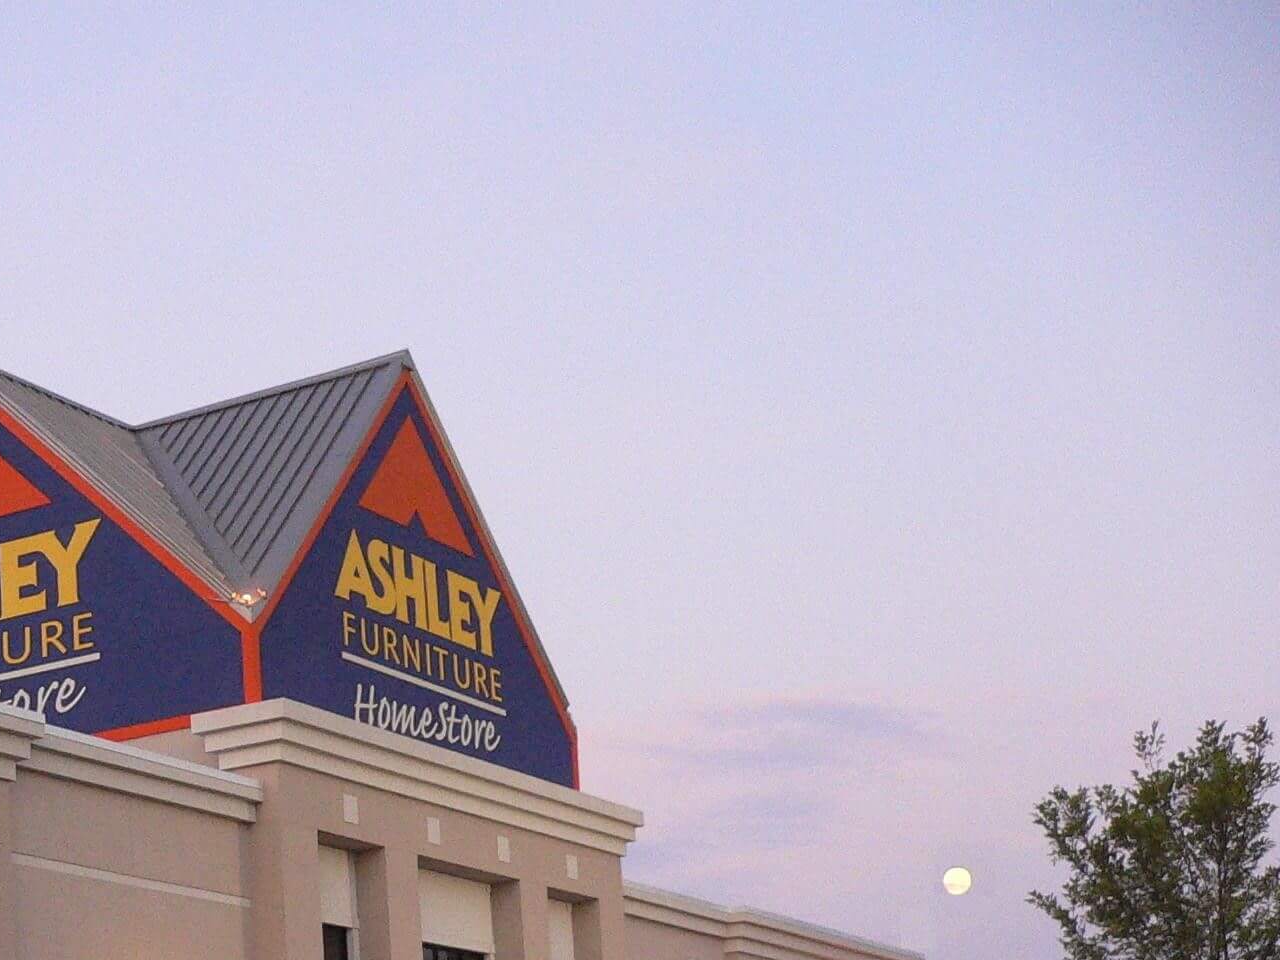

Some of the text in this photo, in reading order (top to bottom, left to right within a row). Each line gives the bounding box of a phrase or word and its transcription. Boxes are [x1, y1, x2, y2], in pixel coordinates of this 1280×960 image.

[334, 528, 501, 657] ASHLEY
[342, 611, 503, 702] FURNITURE
[354, 683, 501, 751] HomeStore
